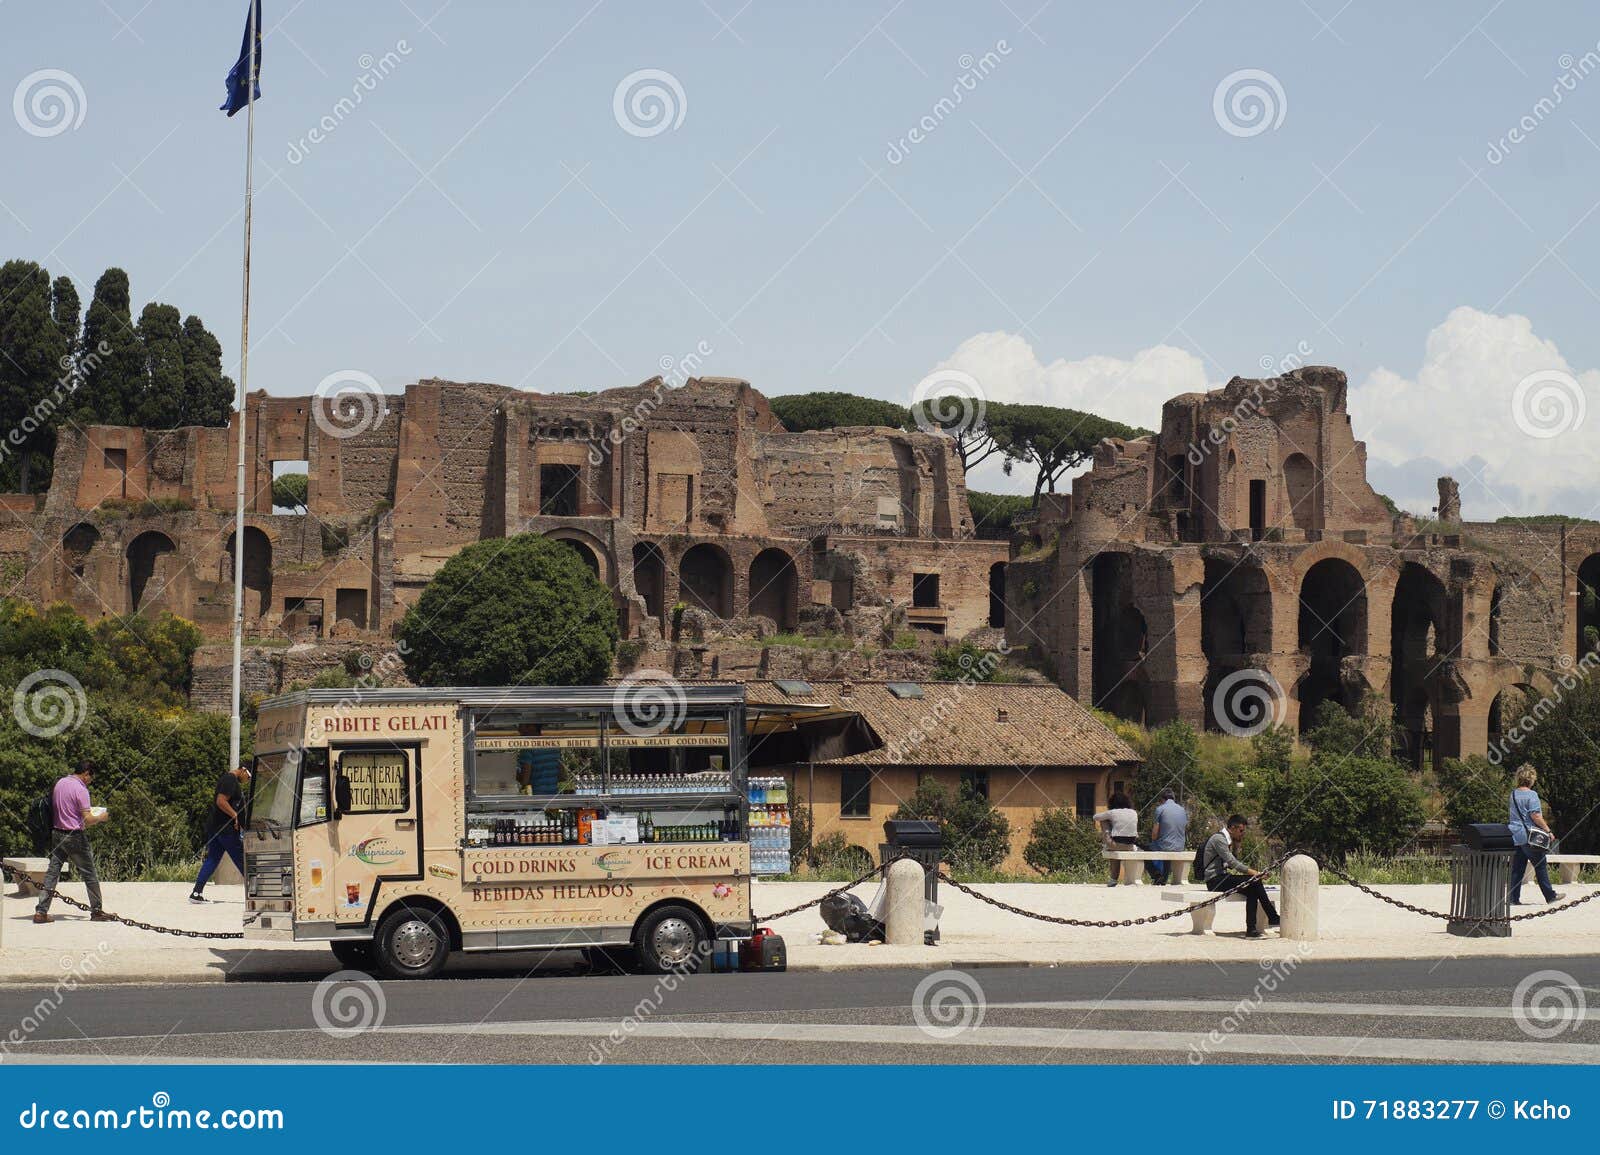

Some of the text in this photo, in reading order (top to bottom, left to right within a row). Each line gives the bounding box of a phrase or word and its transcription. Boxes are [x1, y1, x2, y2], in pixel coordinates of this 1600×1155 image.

[324, 715, 447, 733] BIBITE GELATI
[508, 740, 530, 748] COLD
[531, 739, 560, 747] DRINKS
[611, 738, 638, 746] CREAM
[676, 737, 698, 745] COLD
[699, 737, 727, 745] DRINKS
[346, 766, 401, 783] GELATERIA
[349, 788, 406, 805] RTIGIANALE
[472, 859, 577, 875] COLD DRINKS
[646, 855, 731, 870] ICE CREAM
[472, 884, 634, 902] BEBIDAS HELADOS
